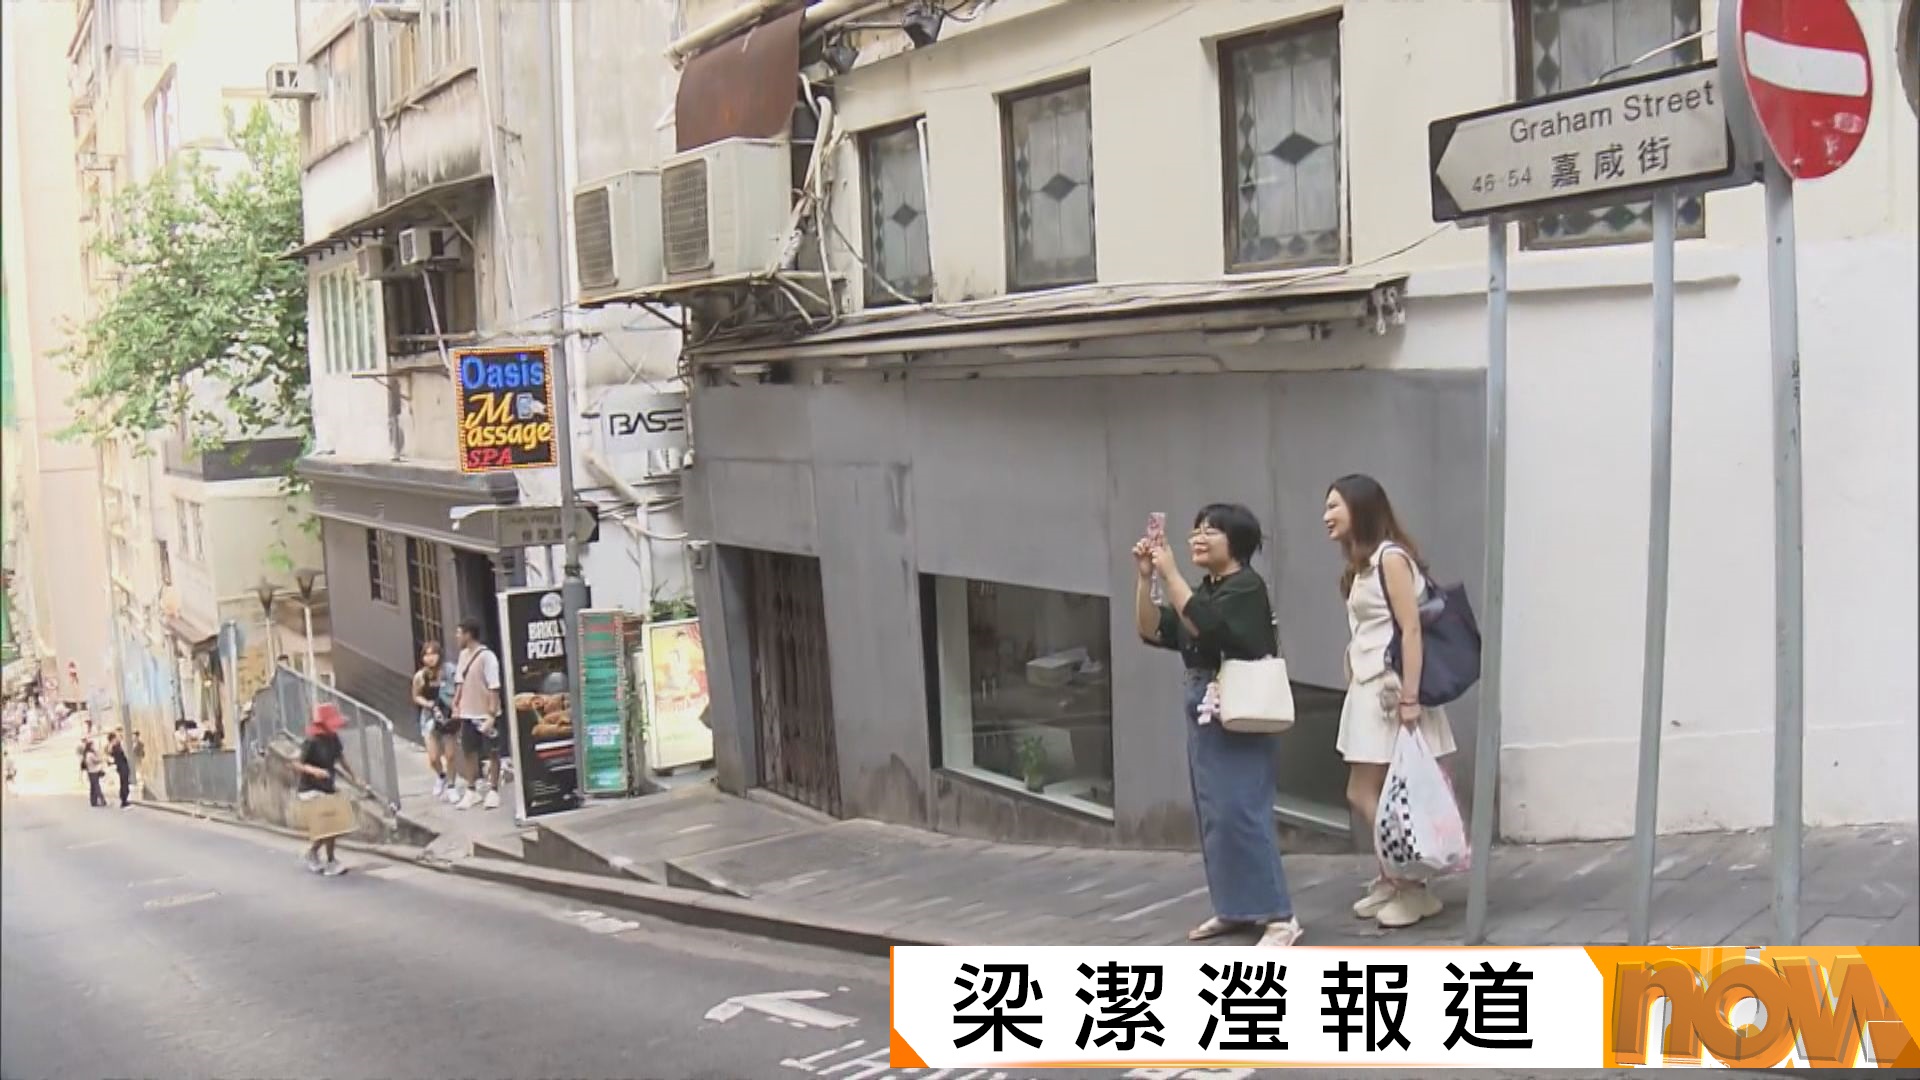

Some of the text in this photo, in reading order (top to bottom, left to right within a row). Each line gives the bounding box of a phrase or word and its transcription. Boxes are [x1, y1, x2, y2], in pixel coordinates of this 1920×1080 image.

[1510, 80, 1714, 144] Graham Street
[1551, 136, 1671, 189] 嘉咸街
[462, 352, 544, 389] Oasis
[609, 408, 684, 436] BASE
[467, 447, 512, 467] SPA
[527, 638, 564, 660] PIZZA
